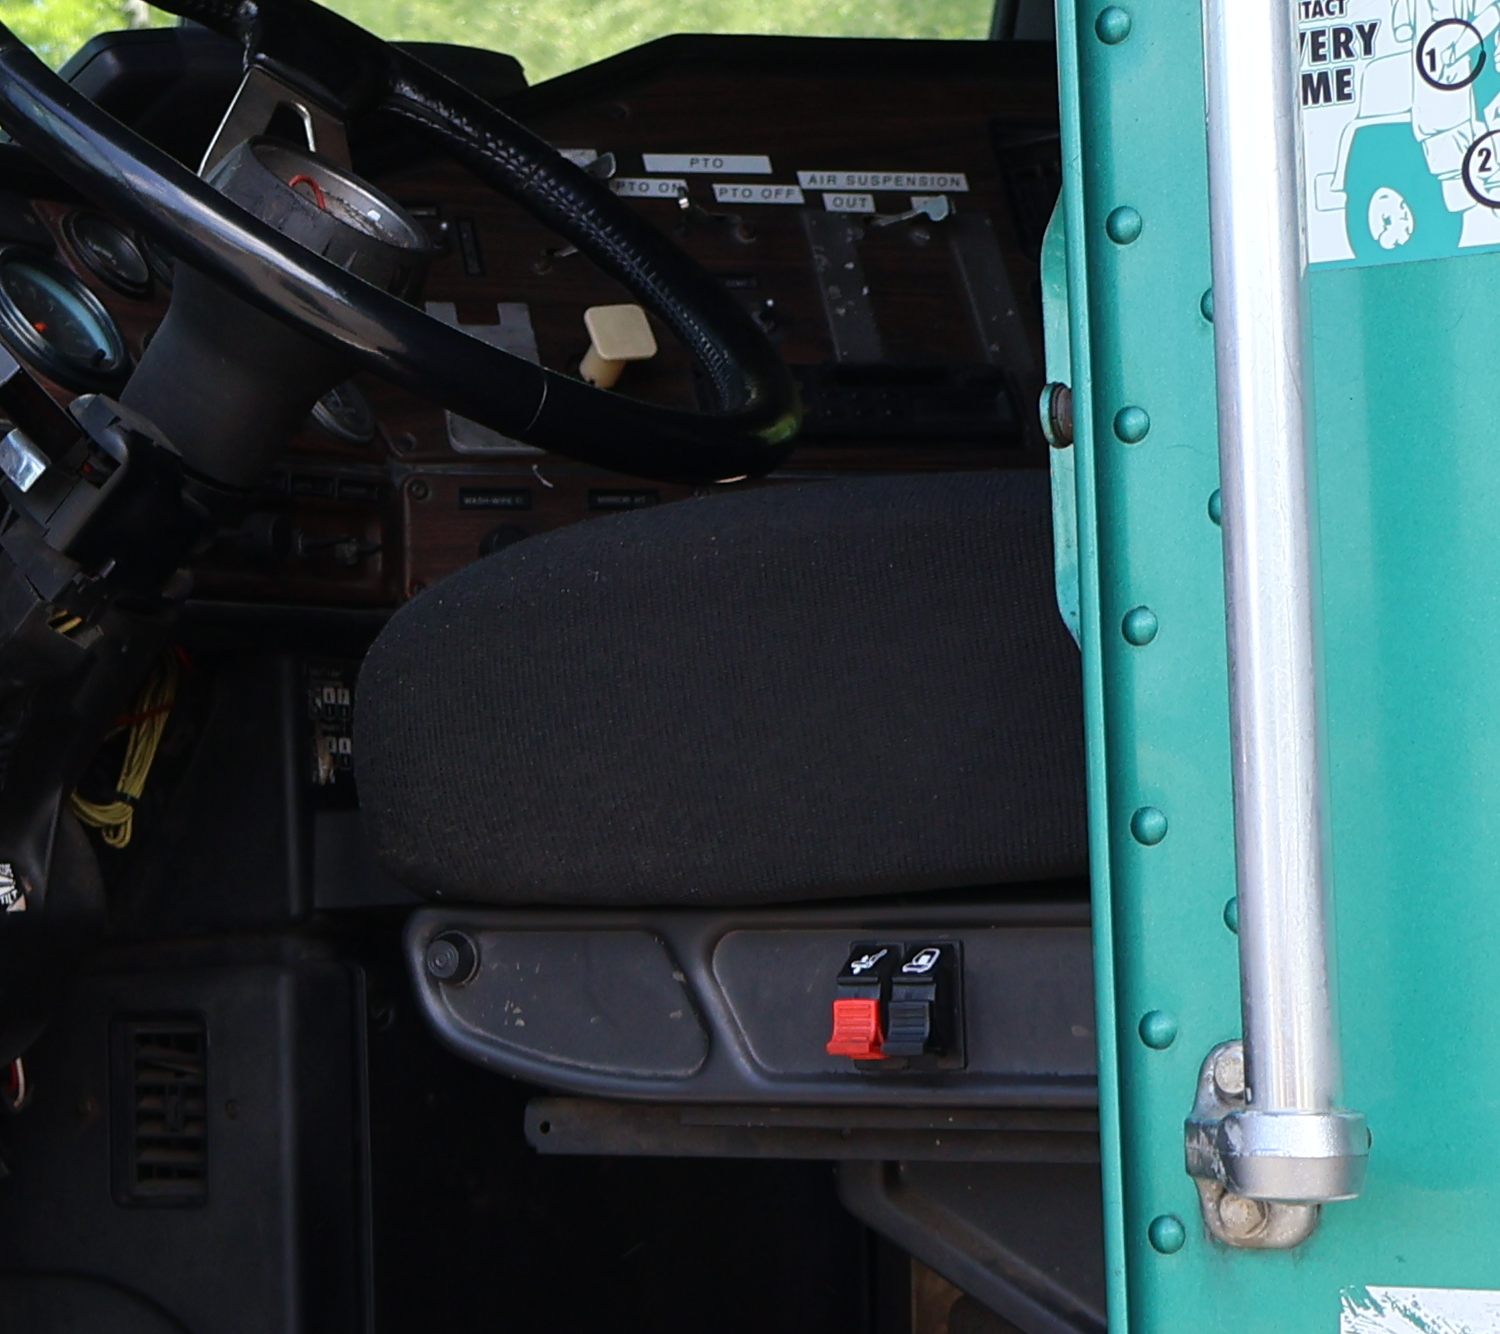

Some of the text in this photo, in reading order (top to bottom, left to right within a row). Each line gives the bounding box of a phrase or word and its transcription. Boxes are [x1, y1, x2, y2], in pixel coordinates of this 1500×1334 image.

[1425, 47, 1438, 73] 1
[689, 156, 724, 170] PTO
[1477, 147, 1492, 173] 2
[615, 181, 655, 195] PTO
[807, 173, 961, 189] AIR SUSPENSION
[718, 187, 797, 201] PTO OFF
[832, 196, 869, 209] OUT
